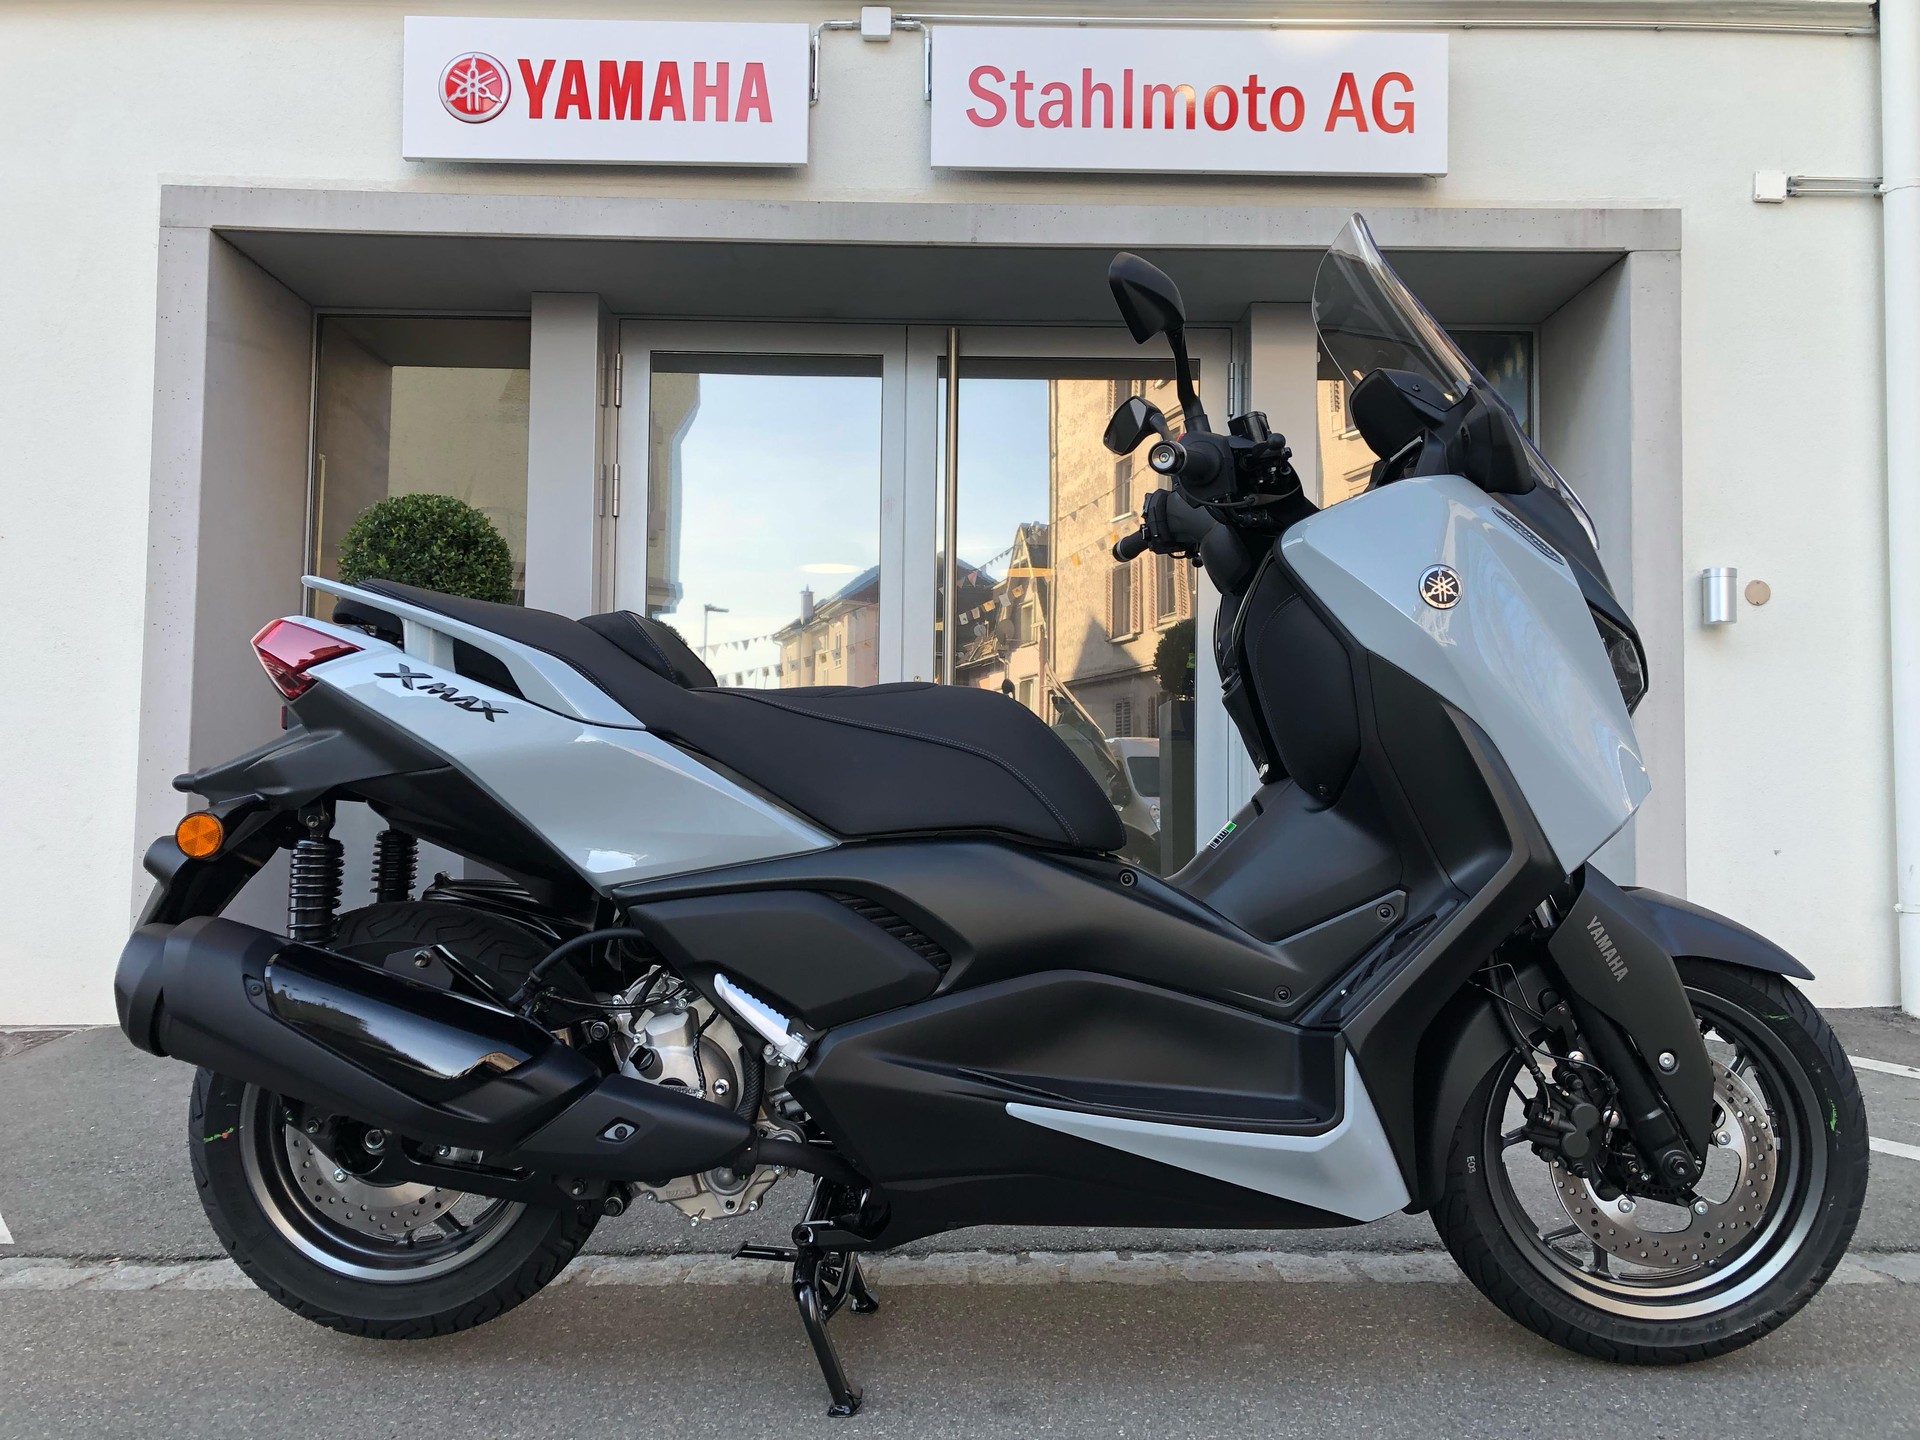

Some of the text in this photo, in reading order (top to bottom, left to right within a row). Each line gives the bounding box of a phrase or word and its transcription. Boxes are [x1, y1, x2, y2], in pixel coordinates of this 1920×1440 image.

[517, 58, 772, 122] YAMAHA
[965, 65, 1415, 134] Stahlmoto AG
[1586, 915, 1629, 982] YAMAHA
